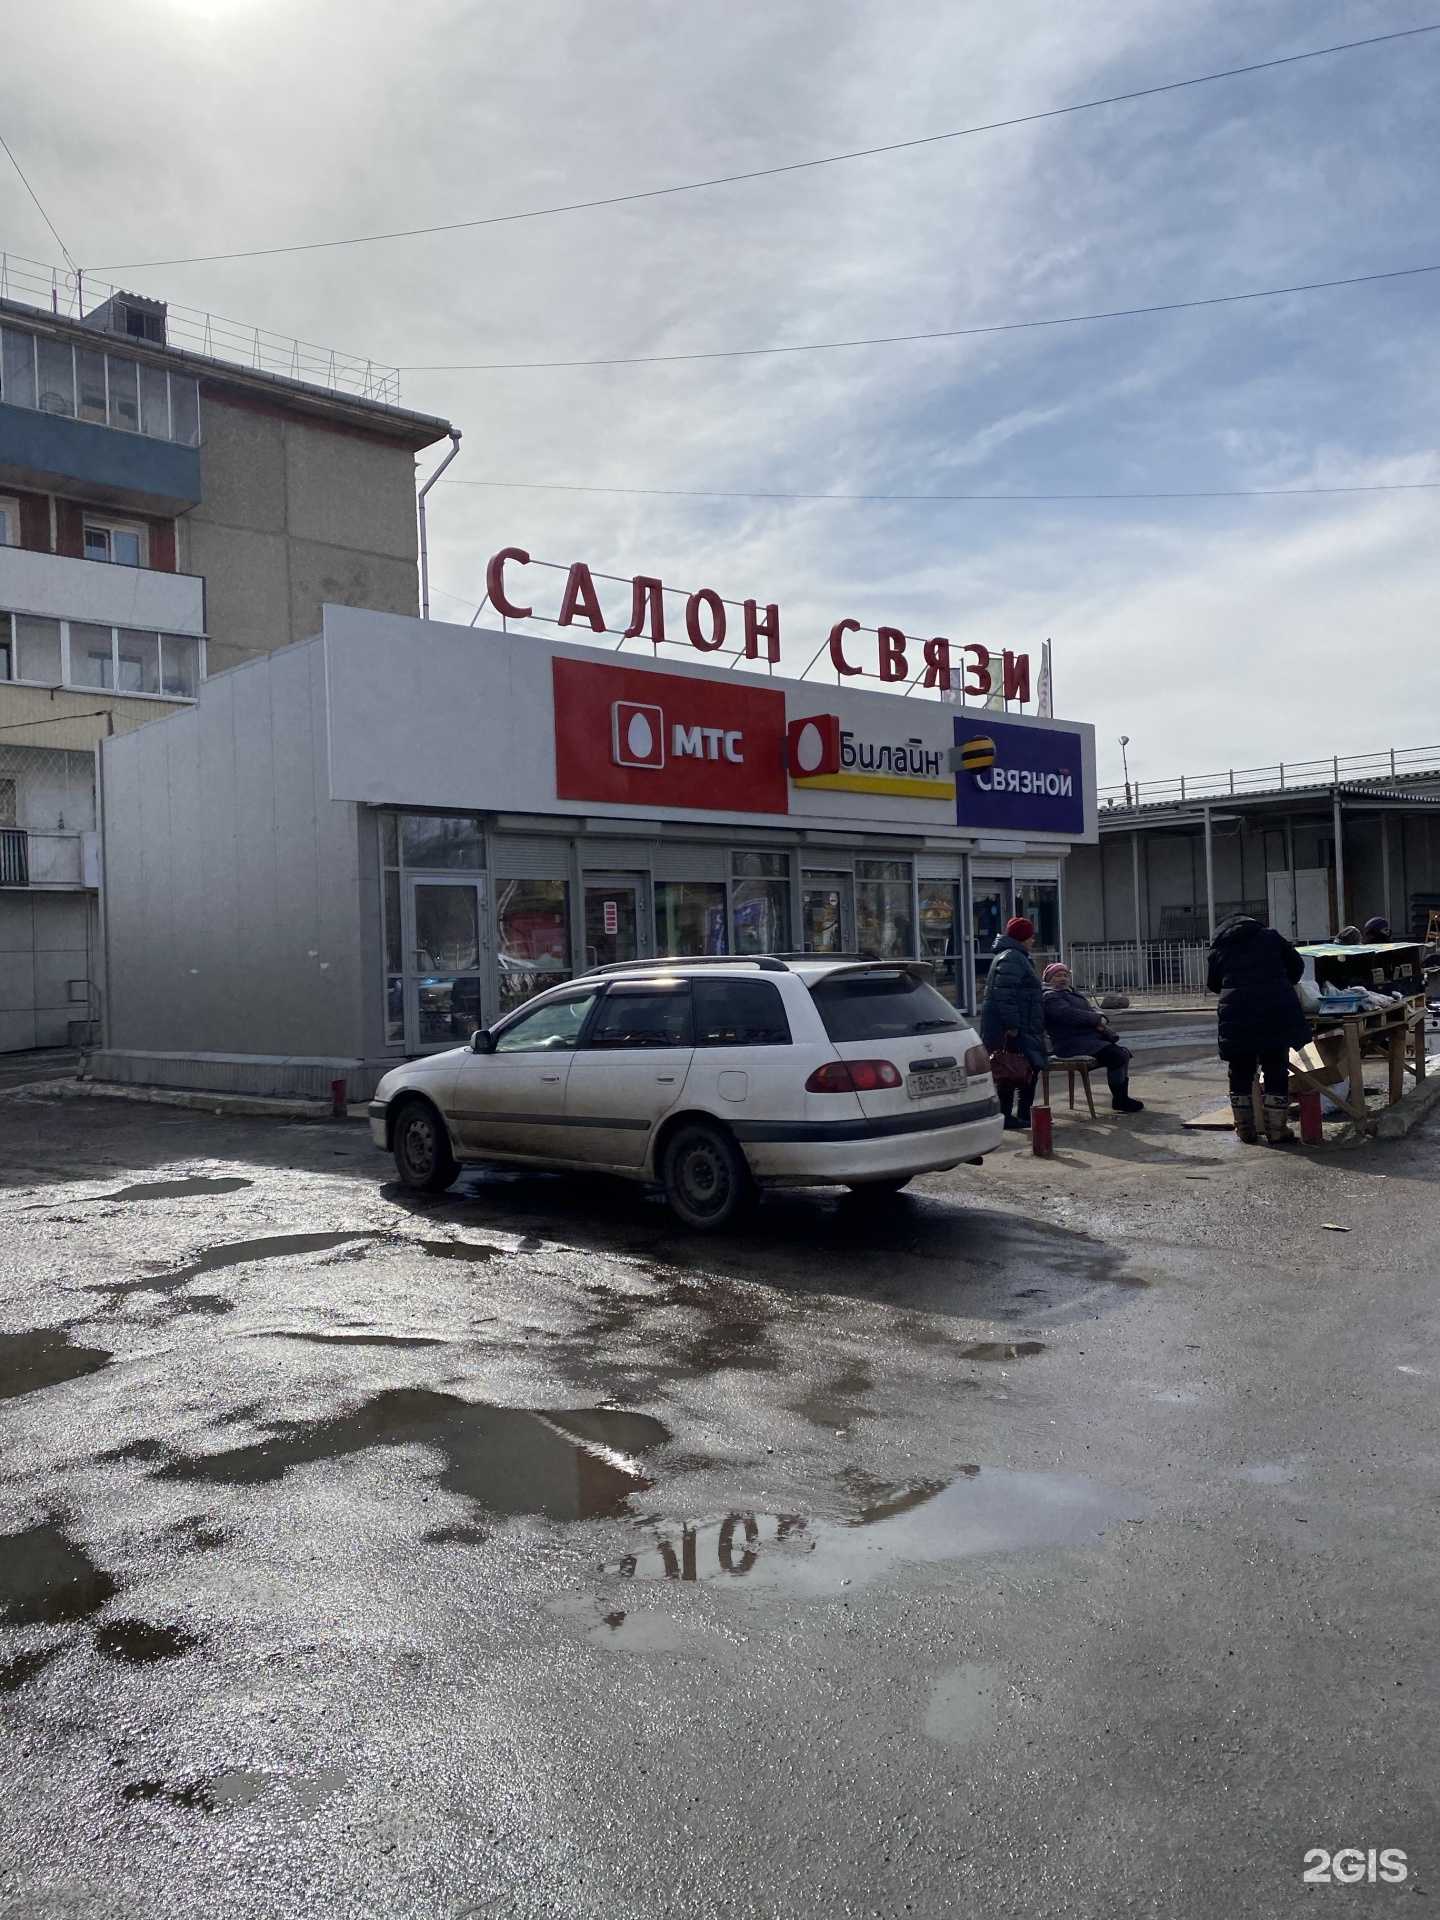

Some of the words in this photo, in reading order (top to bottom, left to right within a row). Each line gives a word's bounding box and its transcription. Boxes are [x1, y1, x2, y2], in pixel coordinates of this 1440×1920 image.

[486, 547, 780, 663] САЛОН
[830, 619, 1030, 703] СВЯЗИ
[671, 724, 744, 763] МТС
[839, 731, 940, 776] Билайн
